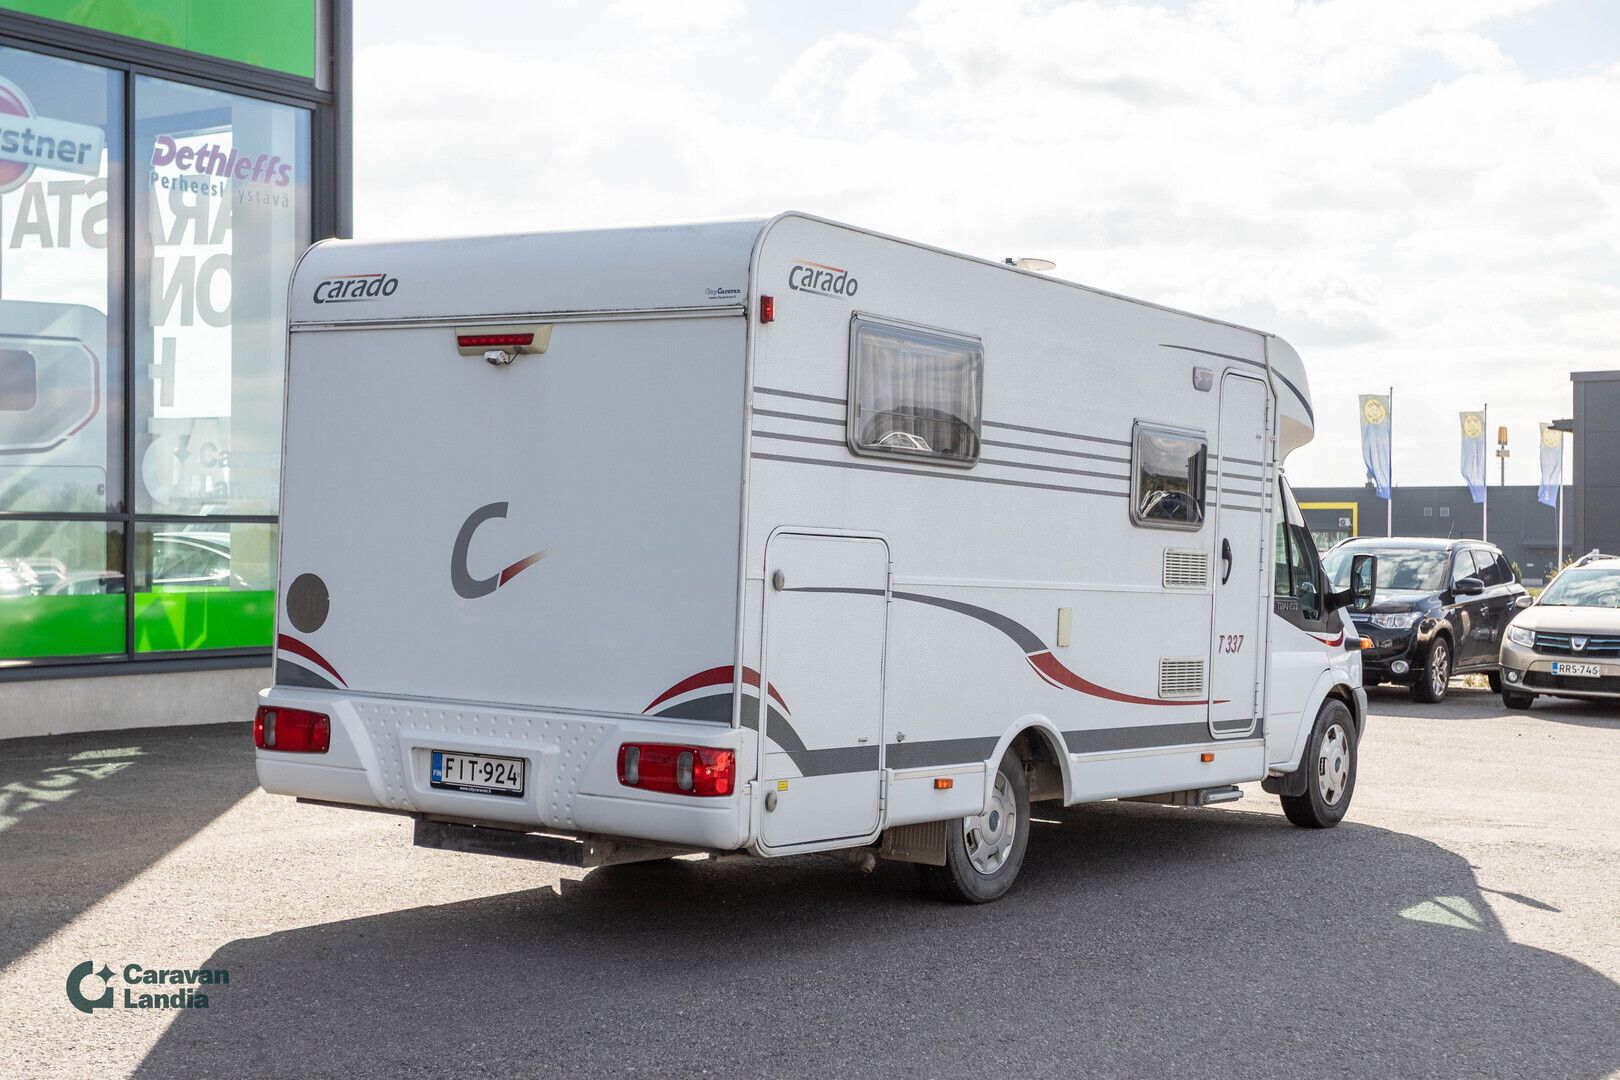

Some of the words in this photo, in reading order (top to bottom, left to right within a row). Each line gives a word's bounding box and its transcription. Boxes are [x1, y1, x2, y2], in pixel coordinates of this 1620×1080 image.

[0, 128, 92, 164] stner
[151, 135, 292, 187] Dethleffs
[1276, 601, 1299, 612] TRANSIT
[1218, 635, 1226, 654] T
[1225, 634, 1245, 655] 337
[445, 757, 518, 786] FIT-924
